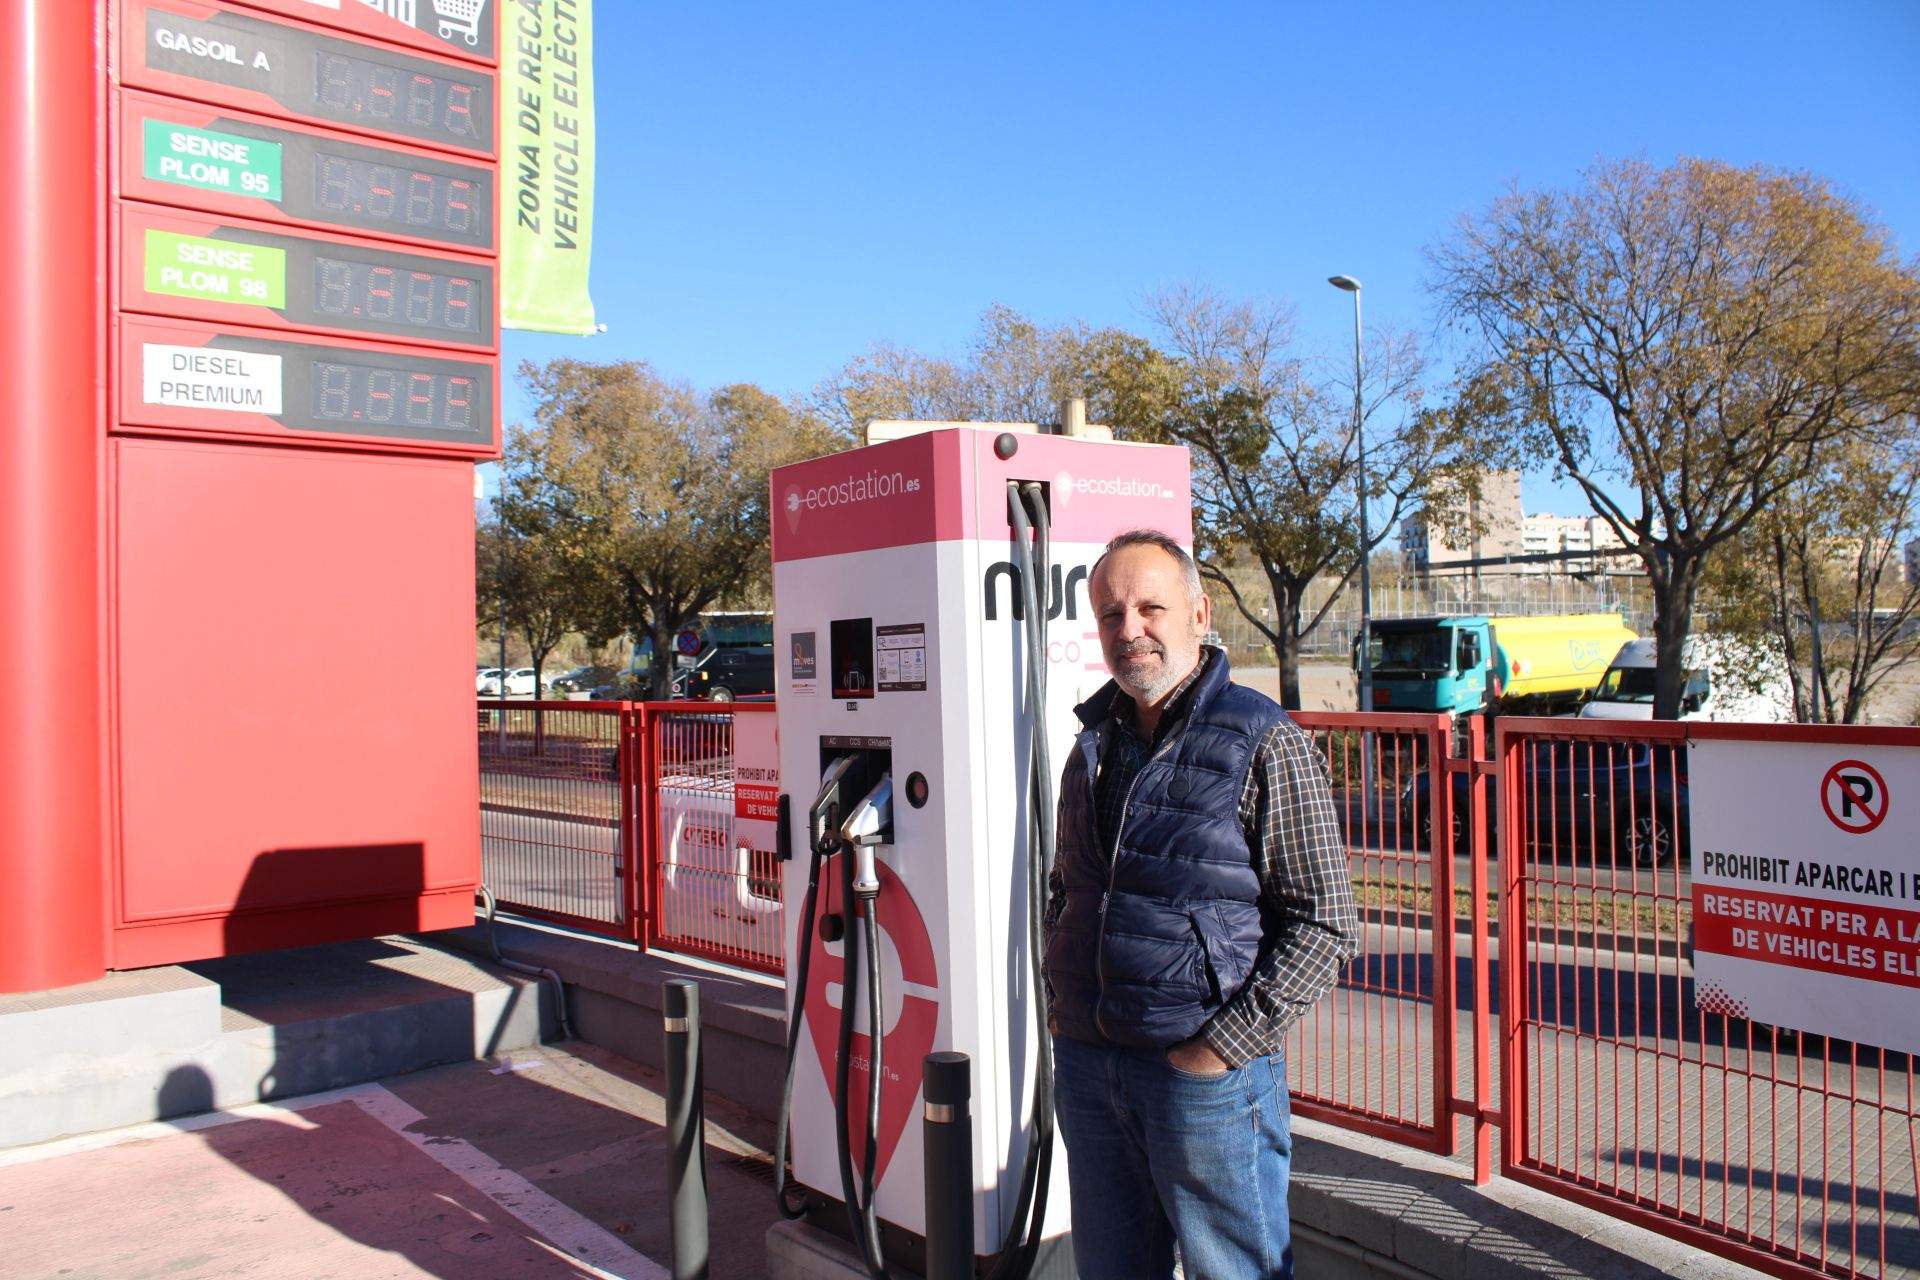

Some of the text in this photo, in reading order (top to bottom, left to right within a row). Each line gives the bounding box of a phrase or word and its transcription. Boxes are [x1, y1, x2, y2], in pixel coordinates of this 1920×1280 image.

[155, 28, 271, 72] GASOIL A
[518, 86, 541, 137] DE
[546, 0, 579, 250] VEHICLE ELÈCT
[169, 131, 250, 165] SENSE
[160, 156, 270, 194] PLOM 95
[518, 145, 541, 235] ZONA
[177, 242, 256, 272] SENSE
[160, 266, 269, 300] PLOM 98
[172, 353, 250, 377] DIESEL
[160, 381, 262, 406] PREMIUM
[806, 469, 921, 510] ecostation.es
[737, 767, 766, 781] PROHIBIT
[737, 788, 774, 802] RESERVAT
[747, 804, 757, 815] DE
[1703, 851, 1789, 885] PROHIBIT
[1795, 861, 1894, 898] APARCAR
[1900, 871, 1906, 899] I
[1703, 893, 1815, 928] RESERVAT
[1820, 909, 1868, 937] PER
[1873, 917, 1892, 940] A
[1732, 927, 1760, 951] DE
[1763, 932, 1877, 969] VEHICLES
